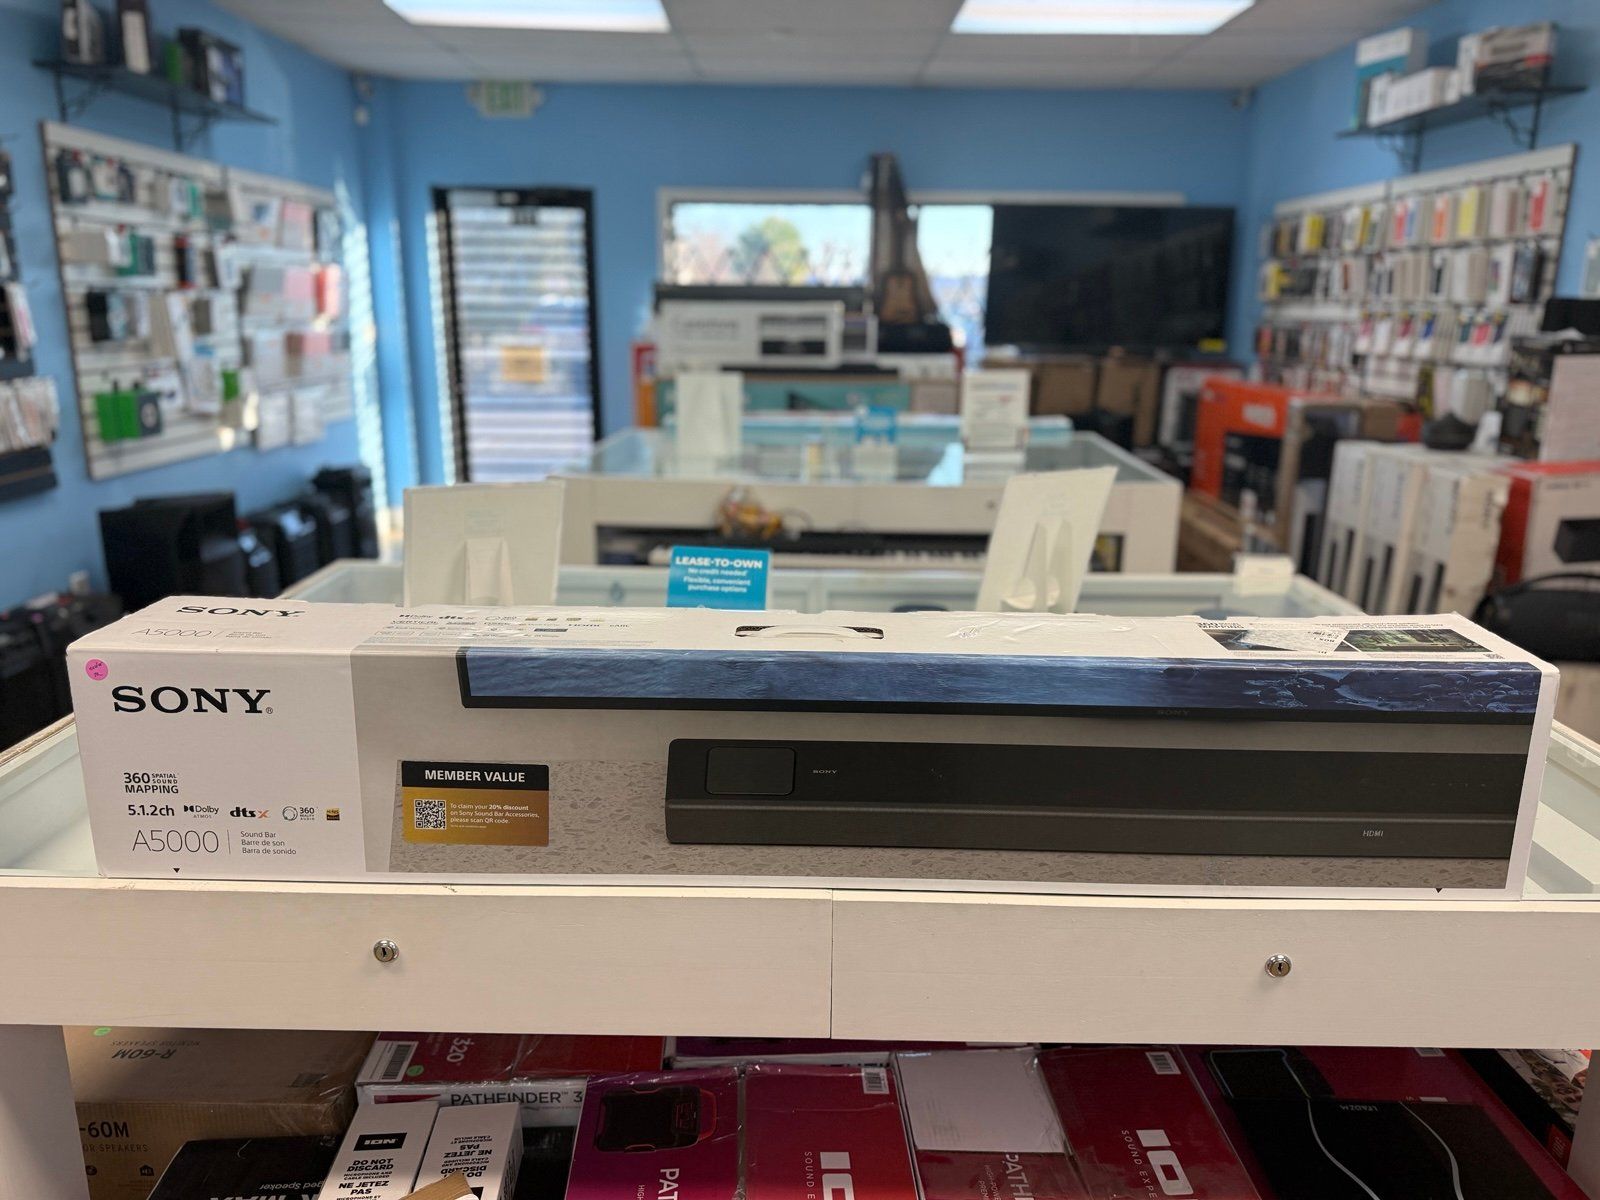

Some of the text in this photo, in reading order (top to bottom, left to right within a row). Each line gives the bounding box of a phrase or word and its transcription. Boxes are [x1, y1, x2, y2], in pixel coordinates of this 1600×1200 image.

[675, 556, 763, 569] LEASE-TO-OWN
[176, 606, 305, 618] SONY
[131, 628, 213, 638] A5000
[112, 686, 271, 714] SONY
[123, 772, 151, 784] 360
[424, 769, 526, 783] MEMBER VALUE
[125, 784, 179, 794] MAPPING
[128, 804, 220, 817] 5.1.2ch Dolby
[299, 806, 315, 815] 360
[504, 811, 541, 819] Accessories,
[132, 829, 220, 854] A5000
[111, 1048, 177, 1059] R-60M
[363, 1138, 398, 1146] ION
[1121, 1129, 1142, 1165] SOUND
[443, 1150, 477, 1158] JETEZ
[346, 1164, 394, 1172] DISCARD
[804, 1151, 815, 1188] SOUND
[356, 1180, 390, 1188] JETEZ
